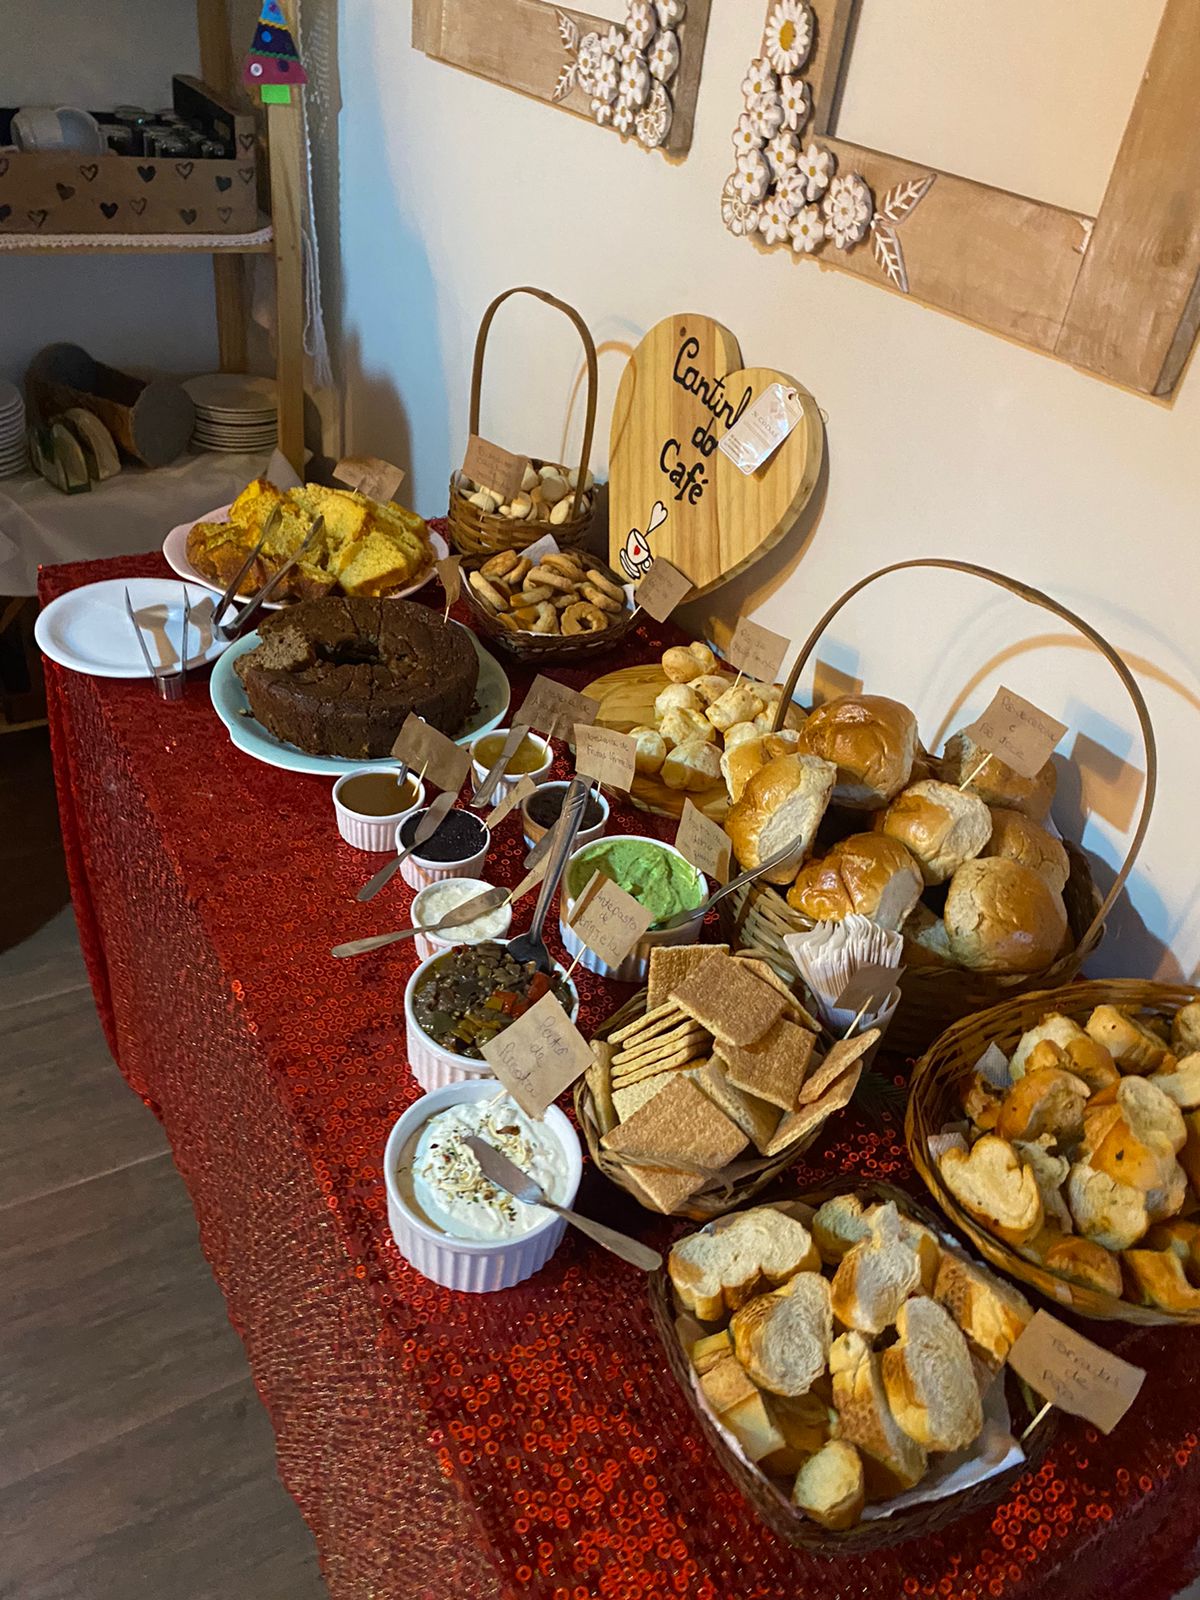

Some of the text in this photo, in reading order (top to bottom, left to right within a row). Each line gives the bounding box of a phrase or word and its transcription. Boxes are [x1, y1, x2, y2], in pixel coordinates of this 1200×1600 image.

[690, 417, 719, 457] do
[659, 438, 710, 506] Café
[599, 911, 609, 925] de
[529, 1042, 546, 1068] de
